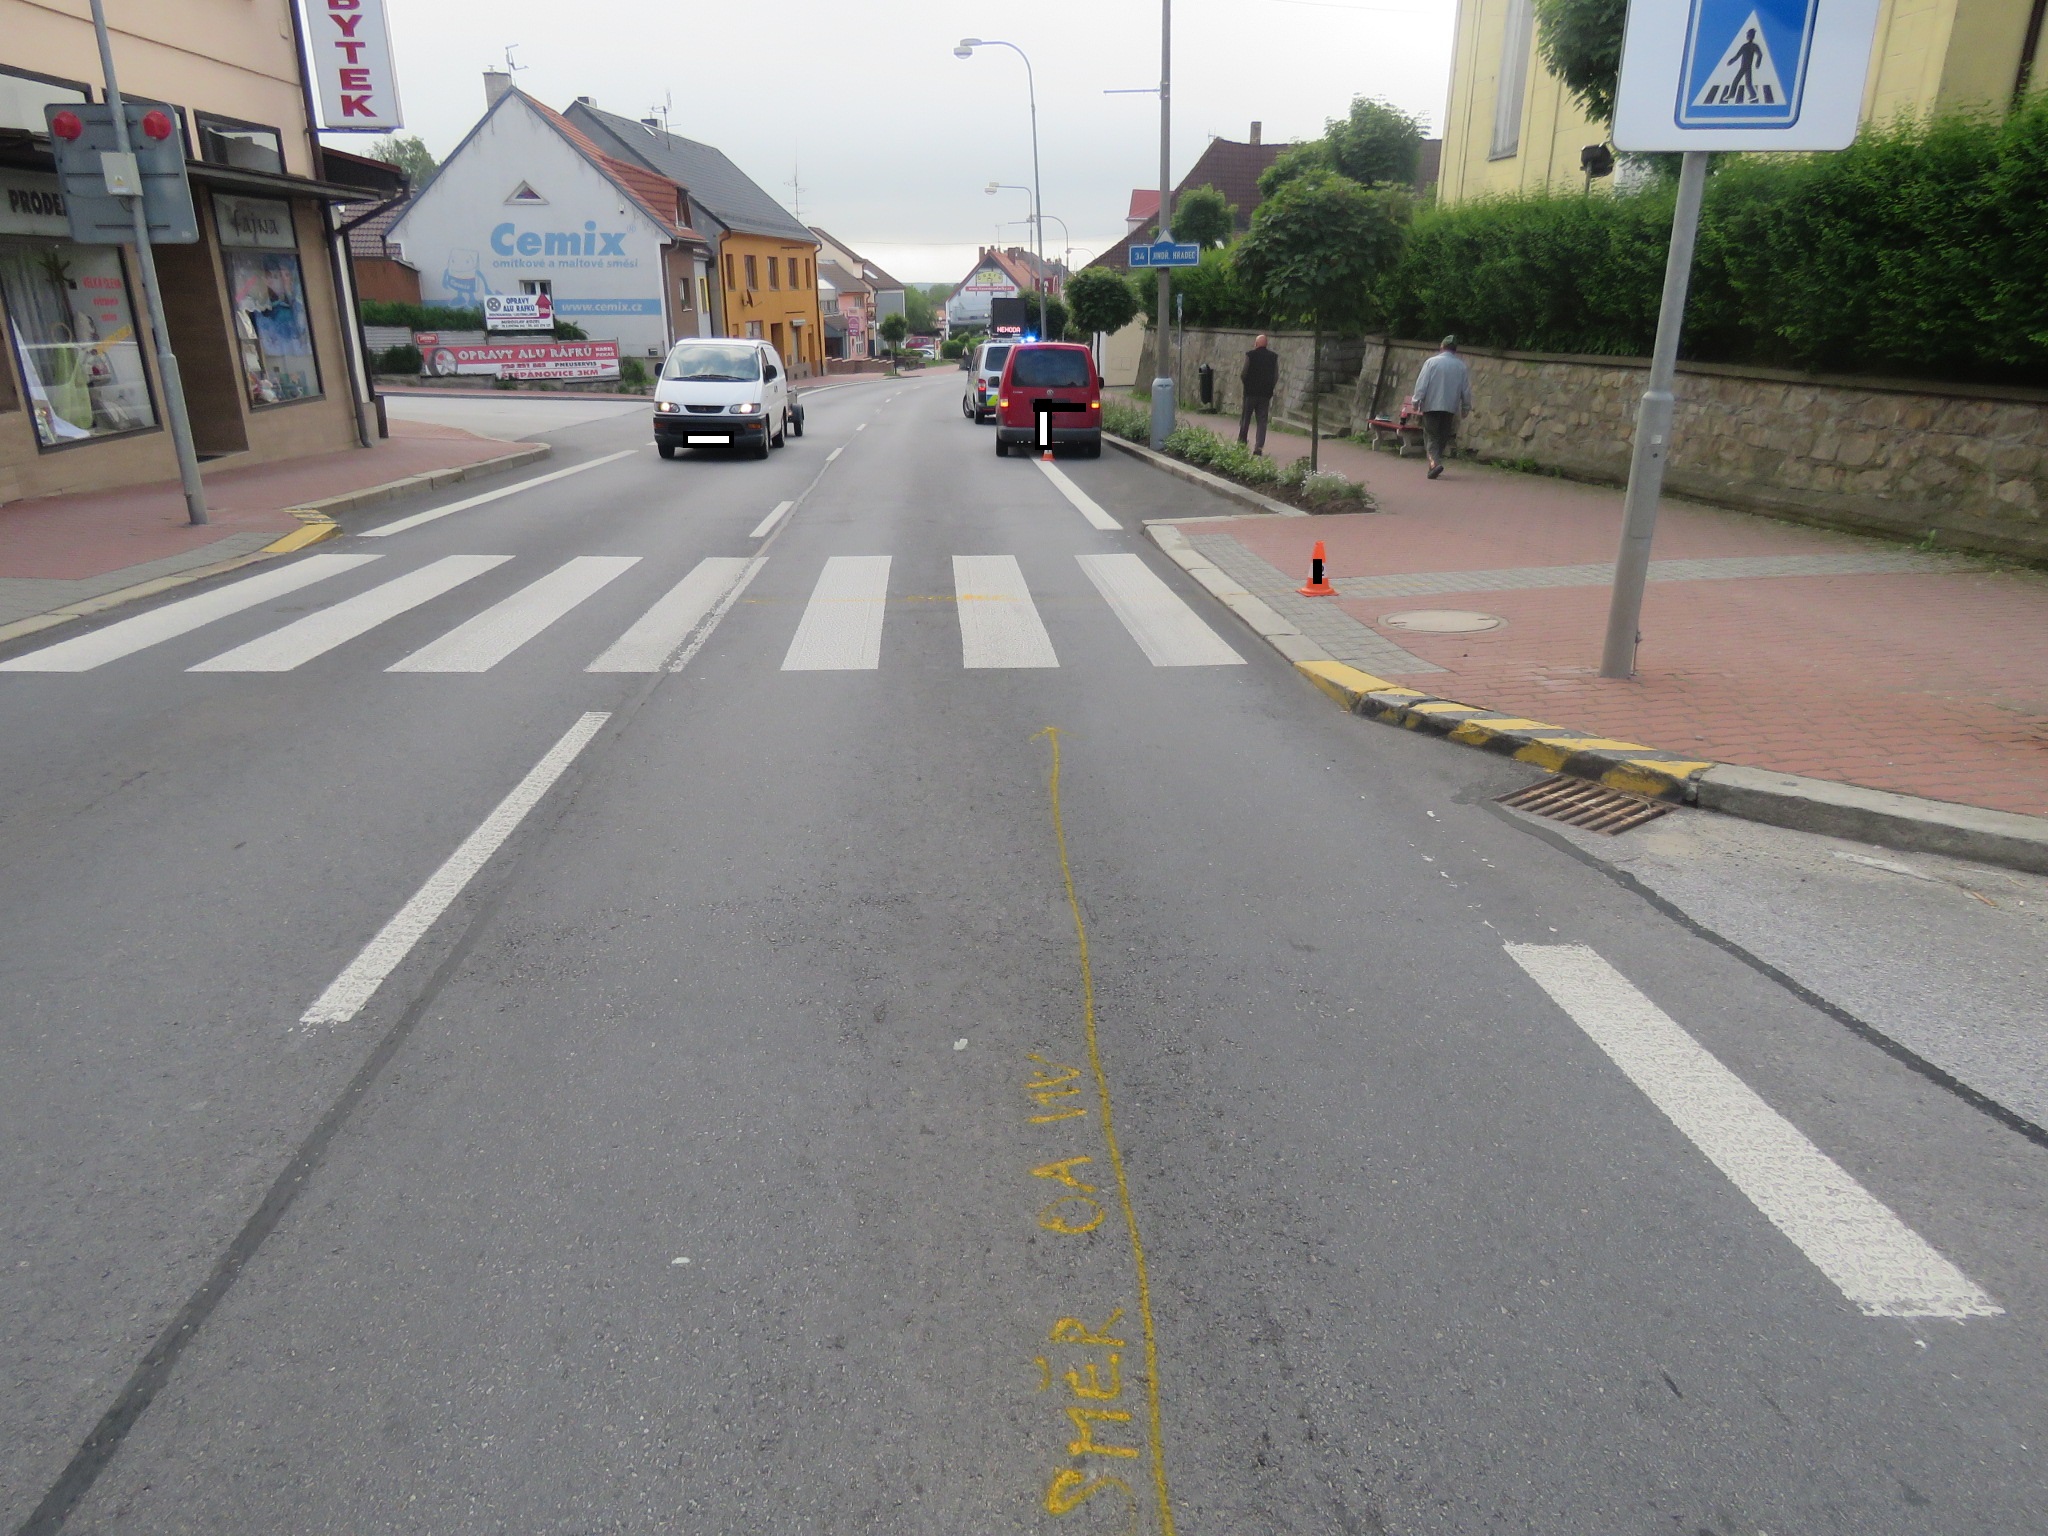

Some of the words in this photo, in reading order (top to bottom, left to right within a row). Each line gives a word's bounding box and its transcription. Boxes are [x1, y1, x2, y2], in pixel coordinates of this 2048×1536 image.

[490, 220, 627, 257] Cemix
[1135, 252, 1145, 261] 34
[1172, 250, 1196, 260] HRADEC
[548, 261, 556, 269] a
[558, 257, 604, 269] maltové
[505, 297, 530, 305] OPRAVY
[561, 301, 643, 312] www.cemix.cz
[503, 305, 515, 313] ALU
[458, 349, 514, 361] OPRAVY
[518, 348, 546, 360] ALU
[550, 345, 592, 358] RÁFKŮ
[577, 369, 599, 377] 3KM
[1033, 1307, 1140, 1516] SMĚR
